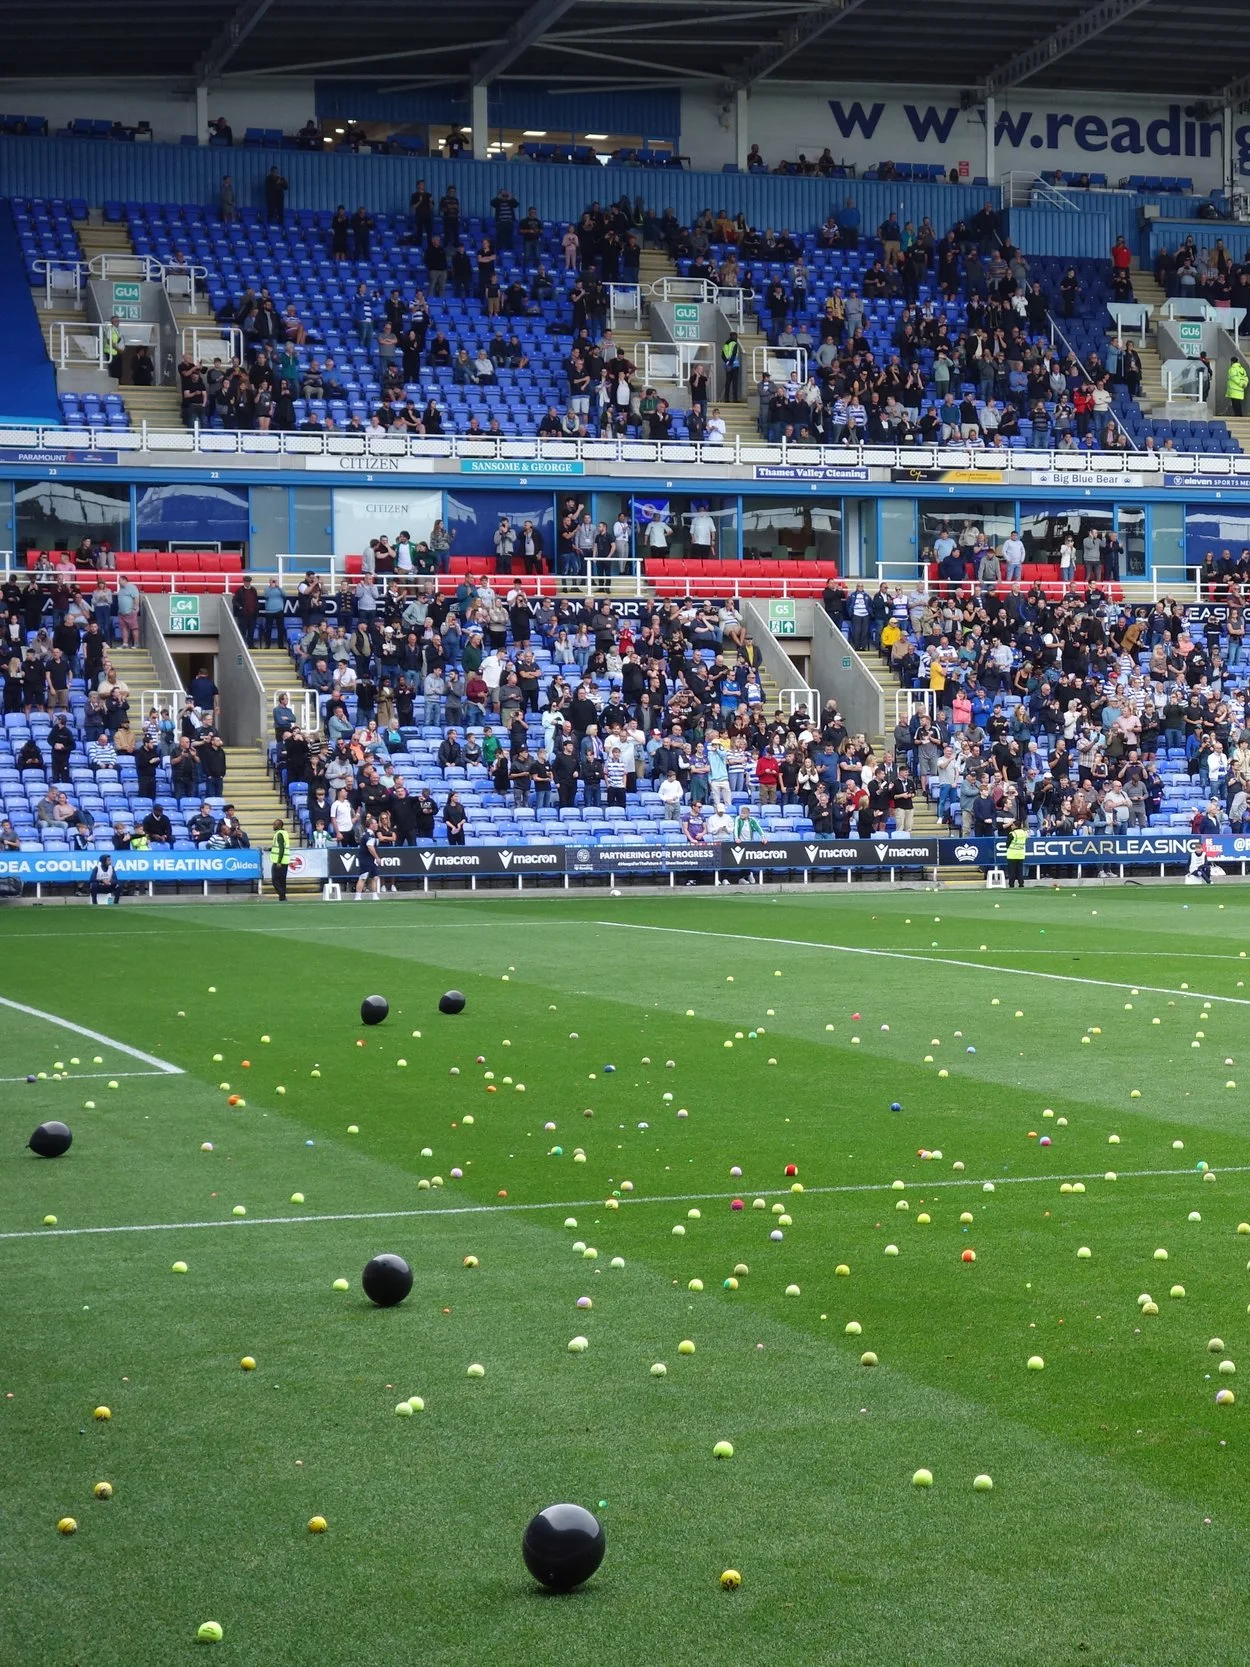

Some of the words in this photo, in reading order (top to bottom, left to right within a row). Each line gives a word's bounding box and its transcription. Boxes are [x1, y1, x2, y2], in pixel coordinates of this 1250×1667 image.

[115, 287, 139, 297] GU4
[676, 309, 697, 318] GU5
[1181, 326, 1200, 336] GU6
[18, 453, 67, 462] PARAMOUNT
[339, 457, 400, 470] CITIZEN
[471, 462, 520, 472] SANSOME
[521, 463, 529, 471] &
[530, 463, 573, 473] GEORGE
[48, 468, 57, 476] 23
[210, 471, 220, 479] 22
[758, 468, 795, 477] Thames
[795, 468, 824, 479] Valley
[825, 469, 867, 479] Cleaning
[1053, 474, 1070, 485] Big
[1072, 474, 1093, 484] Blue
[1096, 475, 1118, 484] Bear
[366, 504, 409, 513] CITIZEN
[176, 600, 192, 611] G4
[775, 604, 789, 615] G5
[888, 847, 929, 857] macron
[996, 839, 1200, 856] SLECTCARLEASING
[513, 854, 557, 864] macron
[600, 851, 651, 860] PARTNERING
[651, 851, 671, 859] FOR
[671, 850, 714, 858] PROGRESS
[746, 849, 787, 859] macron
[435, 855, 480, 865] macron
[38, 860, 102, 873] COOLIN
[114, 859, 150, 872] AND
[154, 858, 223, 871] HEATING
